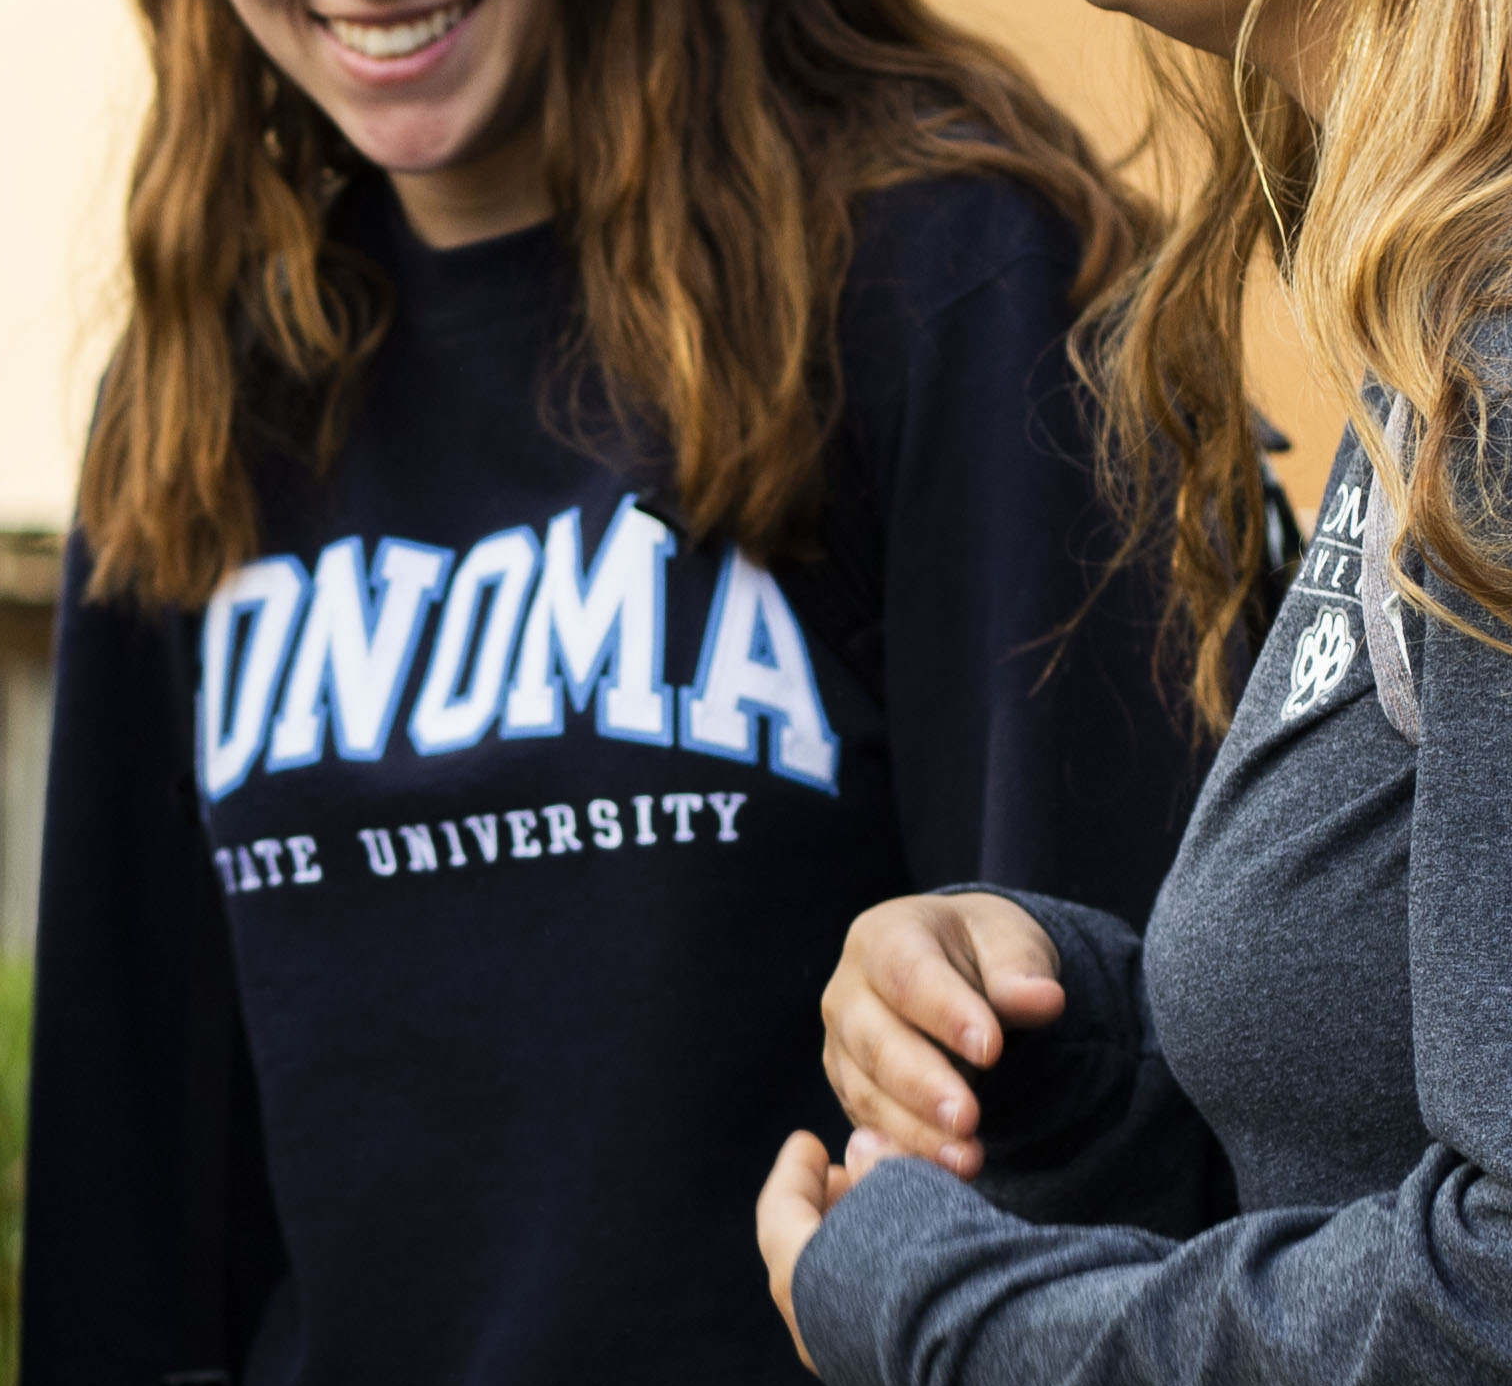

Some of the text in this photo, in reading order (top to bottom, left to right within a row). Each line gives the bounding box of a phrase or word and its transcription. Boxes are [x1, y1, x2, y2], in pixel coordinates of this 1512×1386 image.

[195, 492, 839, 802] ONOMA
[213, 791, 748, 894] TATE UNIVERSITY
